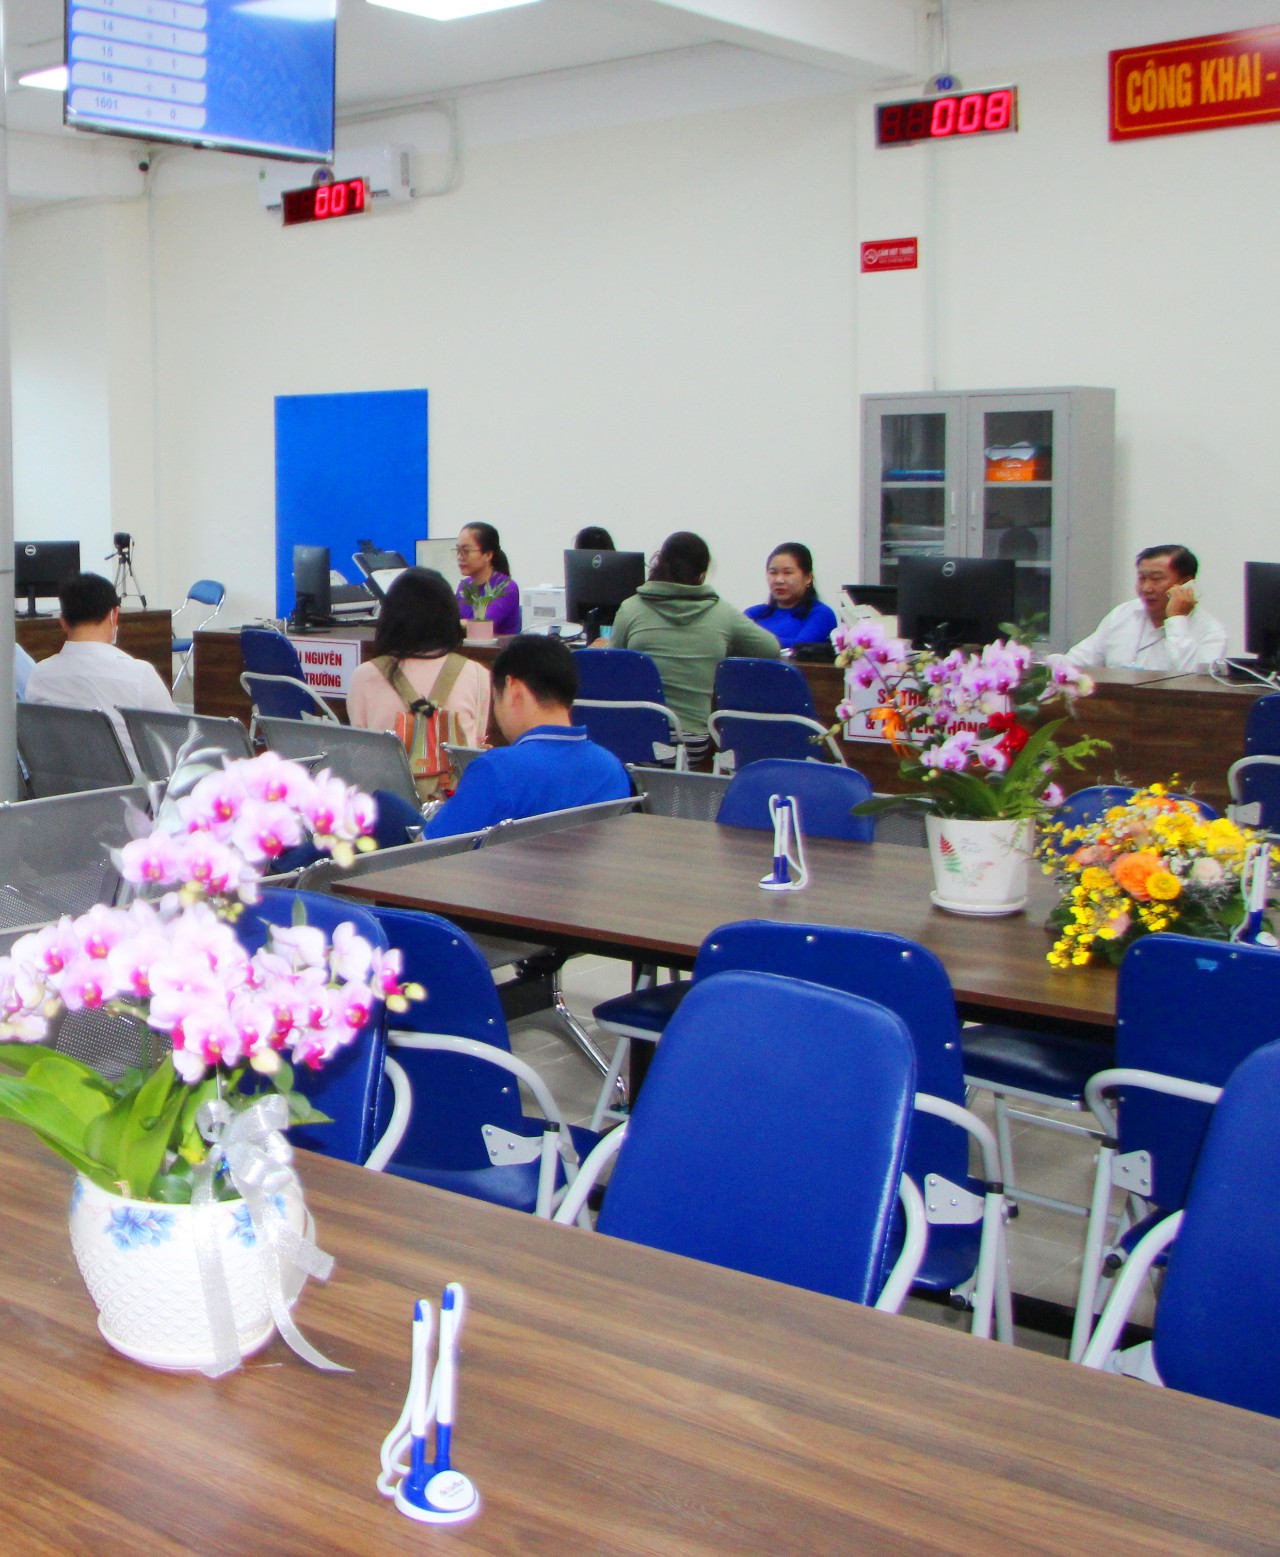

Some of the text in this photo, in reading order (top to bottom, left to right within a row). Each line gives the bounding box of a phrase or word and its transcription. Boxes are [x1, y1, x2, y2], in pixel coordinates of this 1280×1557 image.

[934, 76, 954, 91] 10
[1126, 59, 1193, 115] CÔNG
[1199, 51, 1261, 105] KHAI
[930, 89, 1012, 137] 008
[305, 650, 342, 666] NGUYÊN
[304, 671, 341, 687] TRƯỜNG
